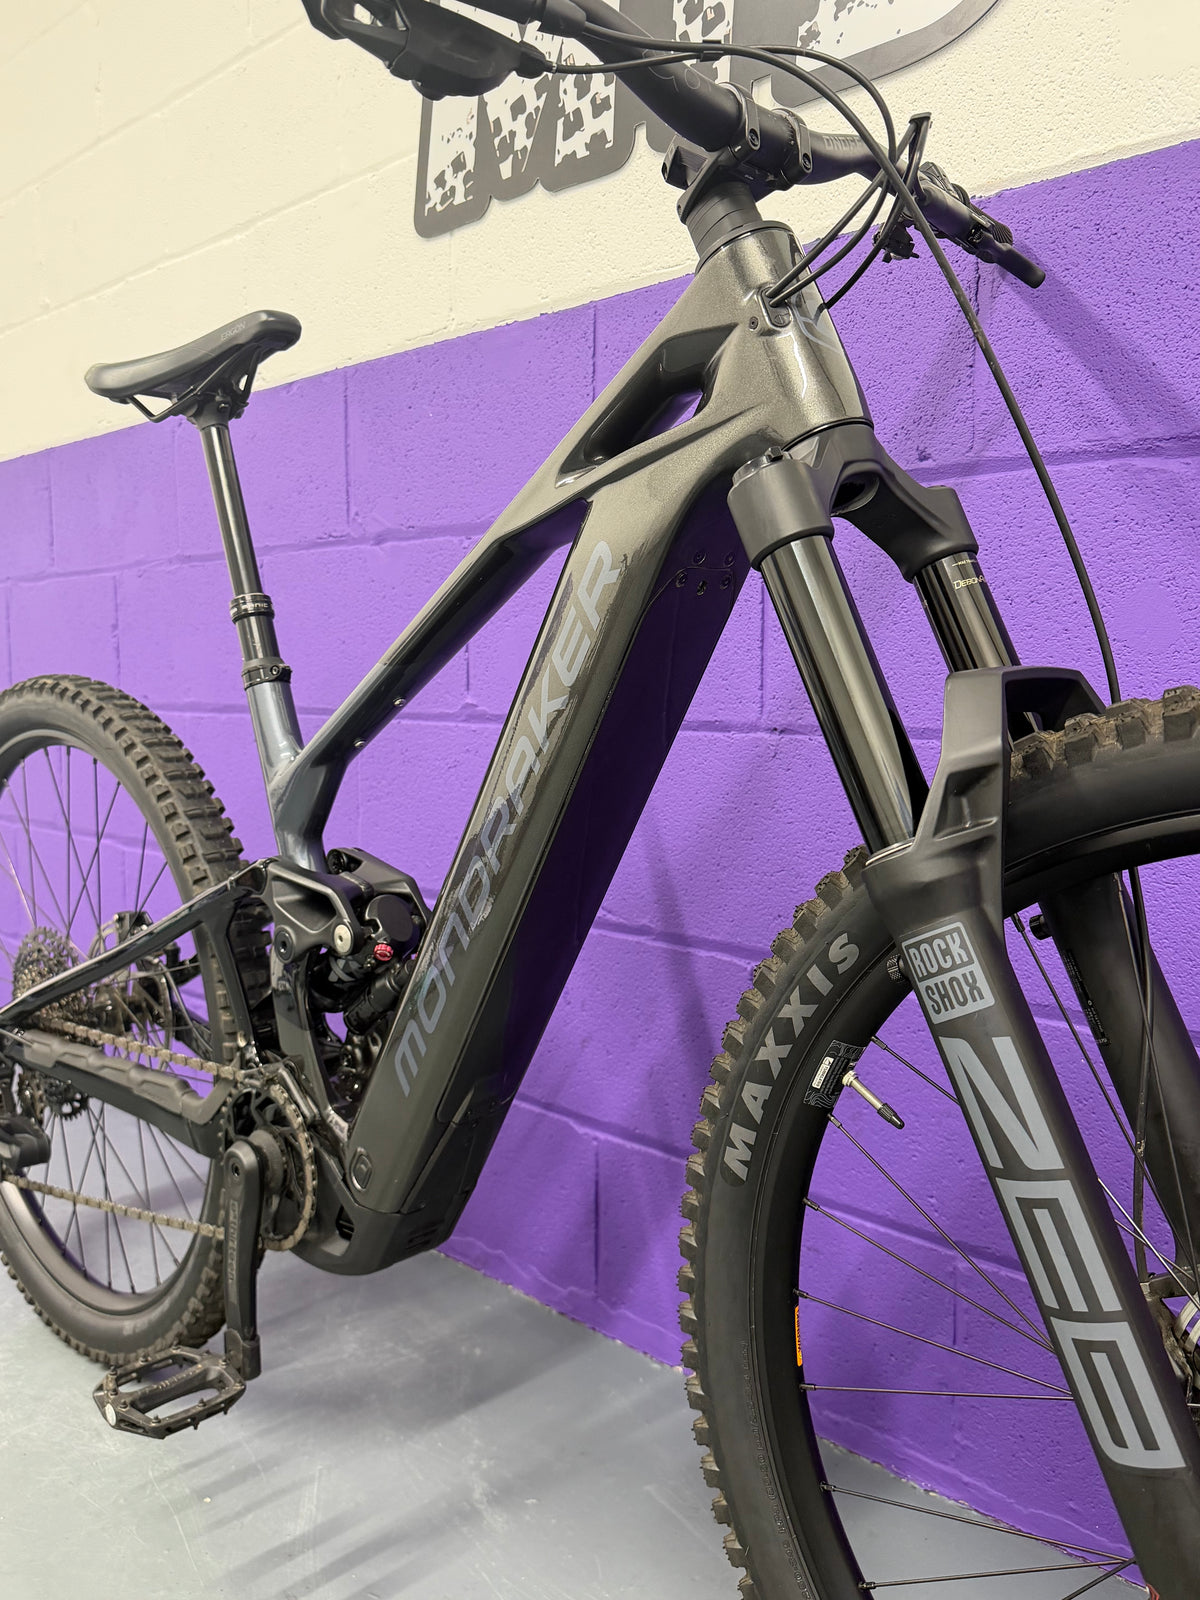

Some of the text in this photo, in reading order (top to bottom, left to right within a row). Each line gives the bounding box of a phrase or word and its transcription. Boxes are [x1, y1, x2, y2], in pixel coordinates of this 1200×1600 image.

[394, 540, 622, 1097] MONDRAKER
[909, 933, 969, 979] ROCK
[924, 970, 984, 1016] SHOX
[723, 933, 860, 1182] MAXXIS
